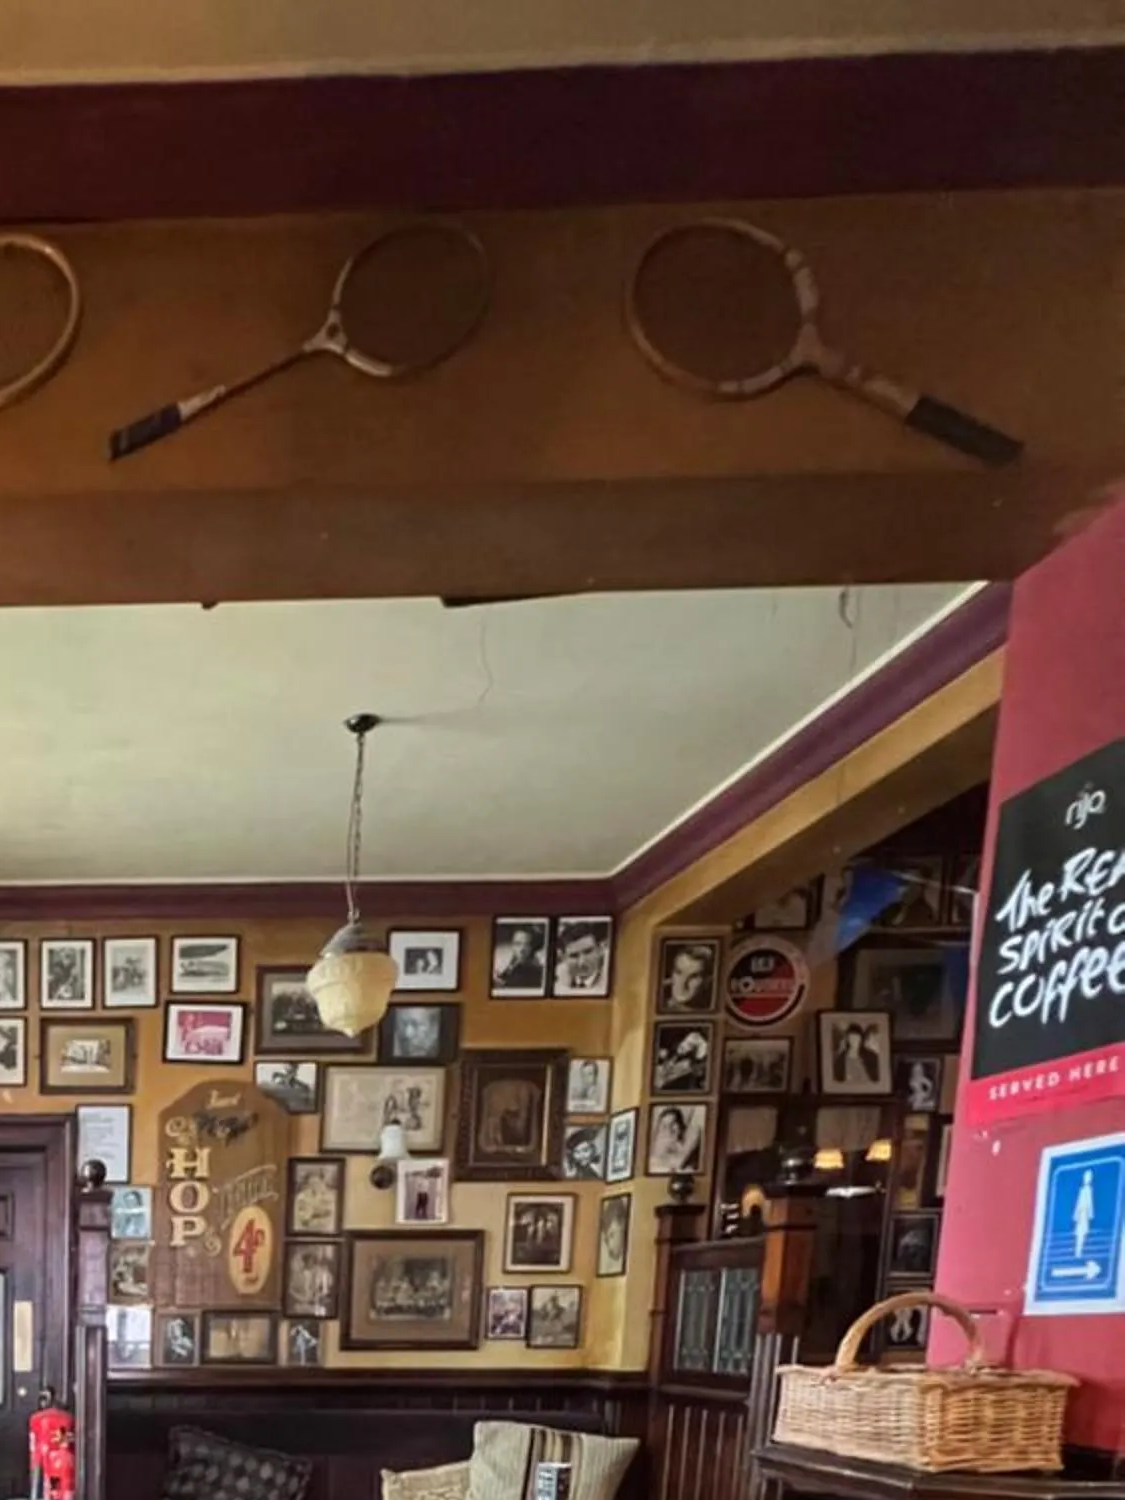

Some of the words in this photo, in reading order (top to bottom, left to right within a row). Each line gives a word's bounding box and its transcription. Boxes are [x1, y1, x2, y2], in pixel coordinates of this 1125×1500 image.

[995, 868, 1055, 932] The
[989, 1071, 1060, 1100] SERVED
[1068, 1056, 1120, 1081] HERE
[166, 1147, 211, 1246] HOP
